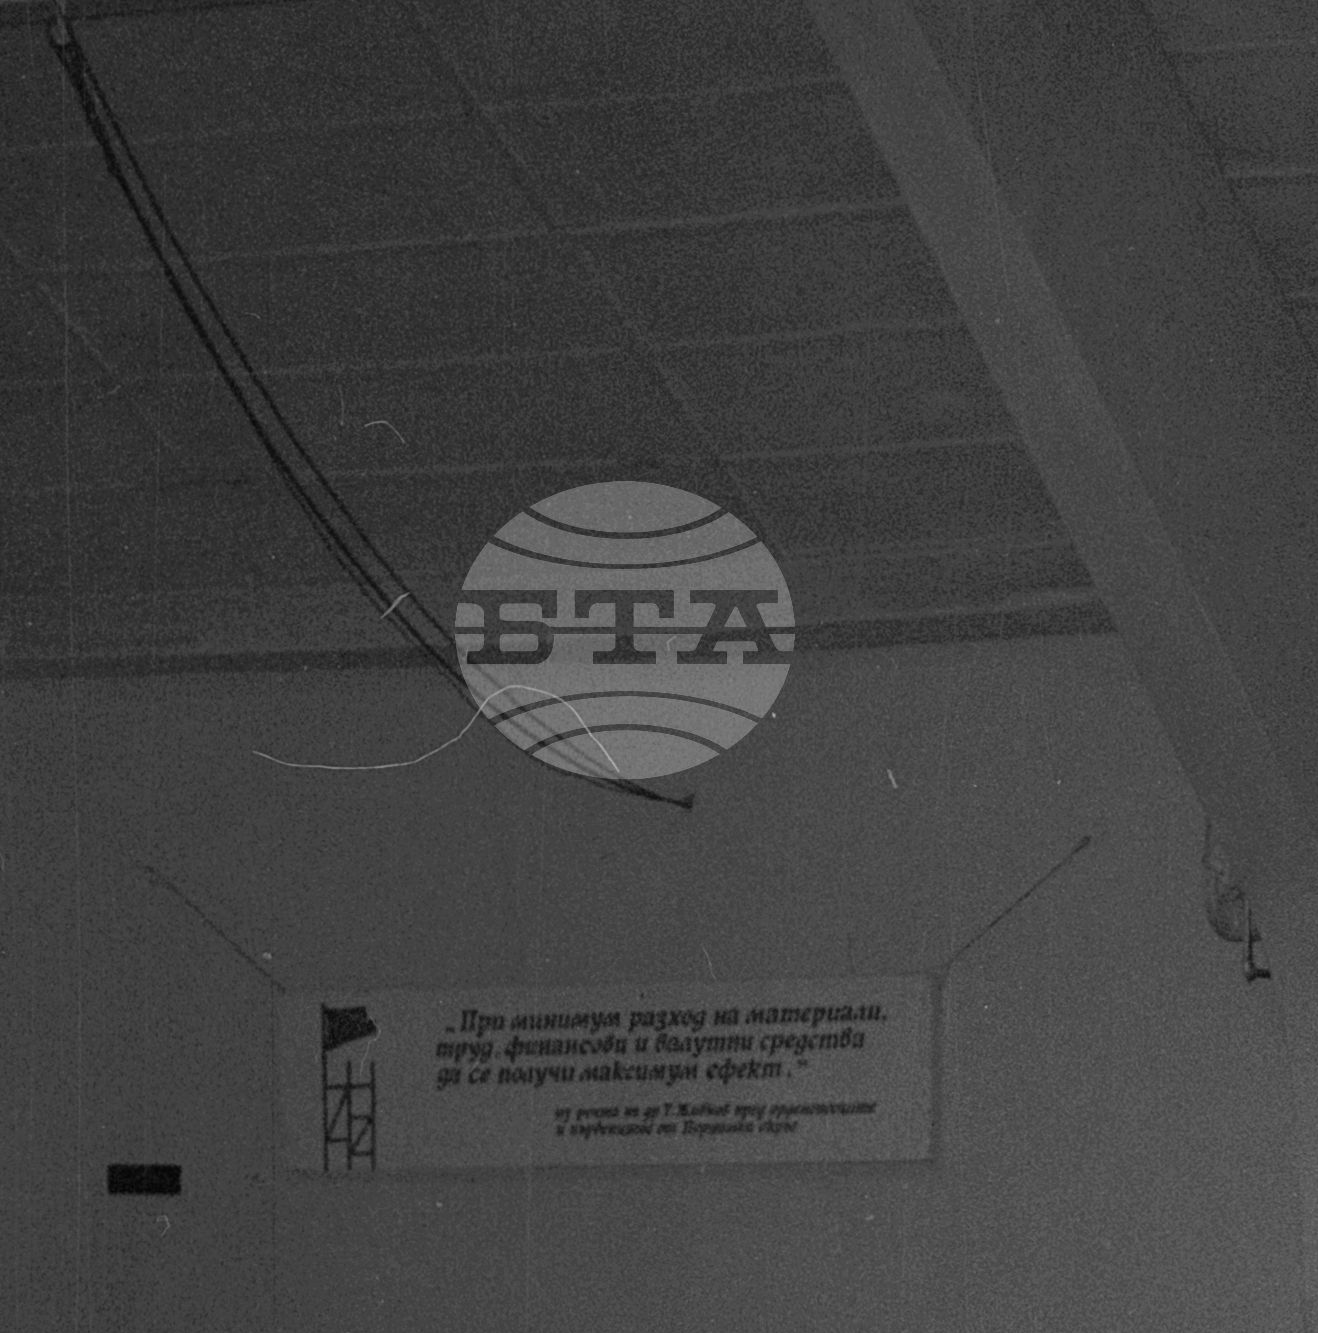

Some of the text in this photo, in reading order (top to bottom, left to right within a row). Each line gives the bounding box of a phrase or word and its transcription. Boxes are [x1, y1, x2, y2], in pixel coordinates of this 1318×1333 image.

[510, 1011, 621, 1035] минимум
[628, 1009, 707, 1033] разход
[713, 1006, 740, 1026] на
[504, 1035, 627, 1063] финансови
[635, 1036, 649, 1052] и
[655, 1033, 755, 1058] валутни
[759, 1027, 866, 1056] средства
[435, 1066, 462, 1092] да
[467, 1066, 492, 1085] се
[496, 1064, 576, 1088] получи
[579, 1060, 699, 1087] максимум
